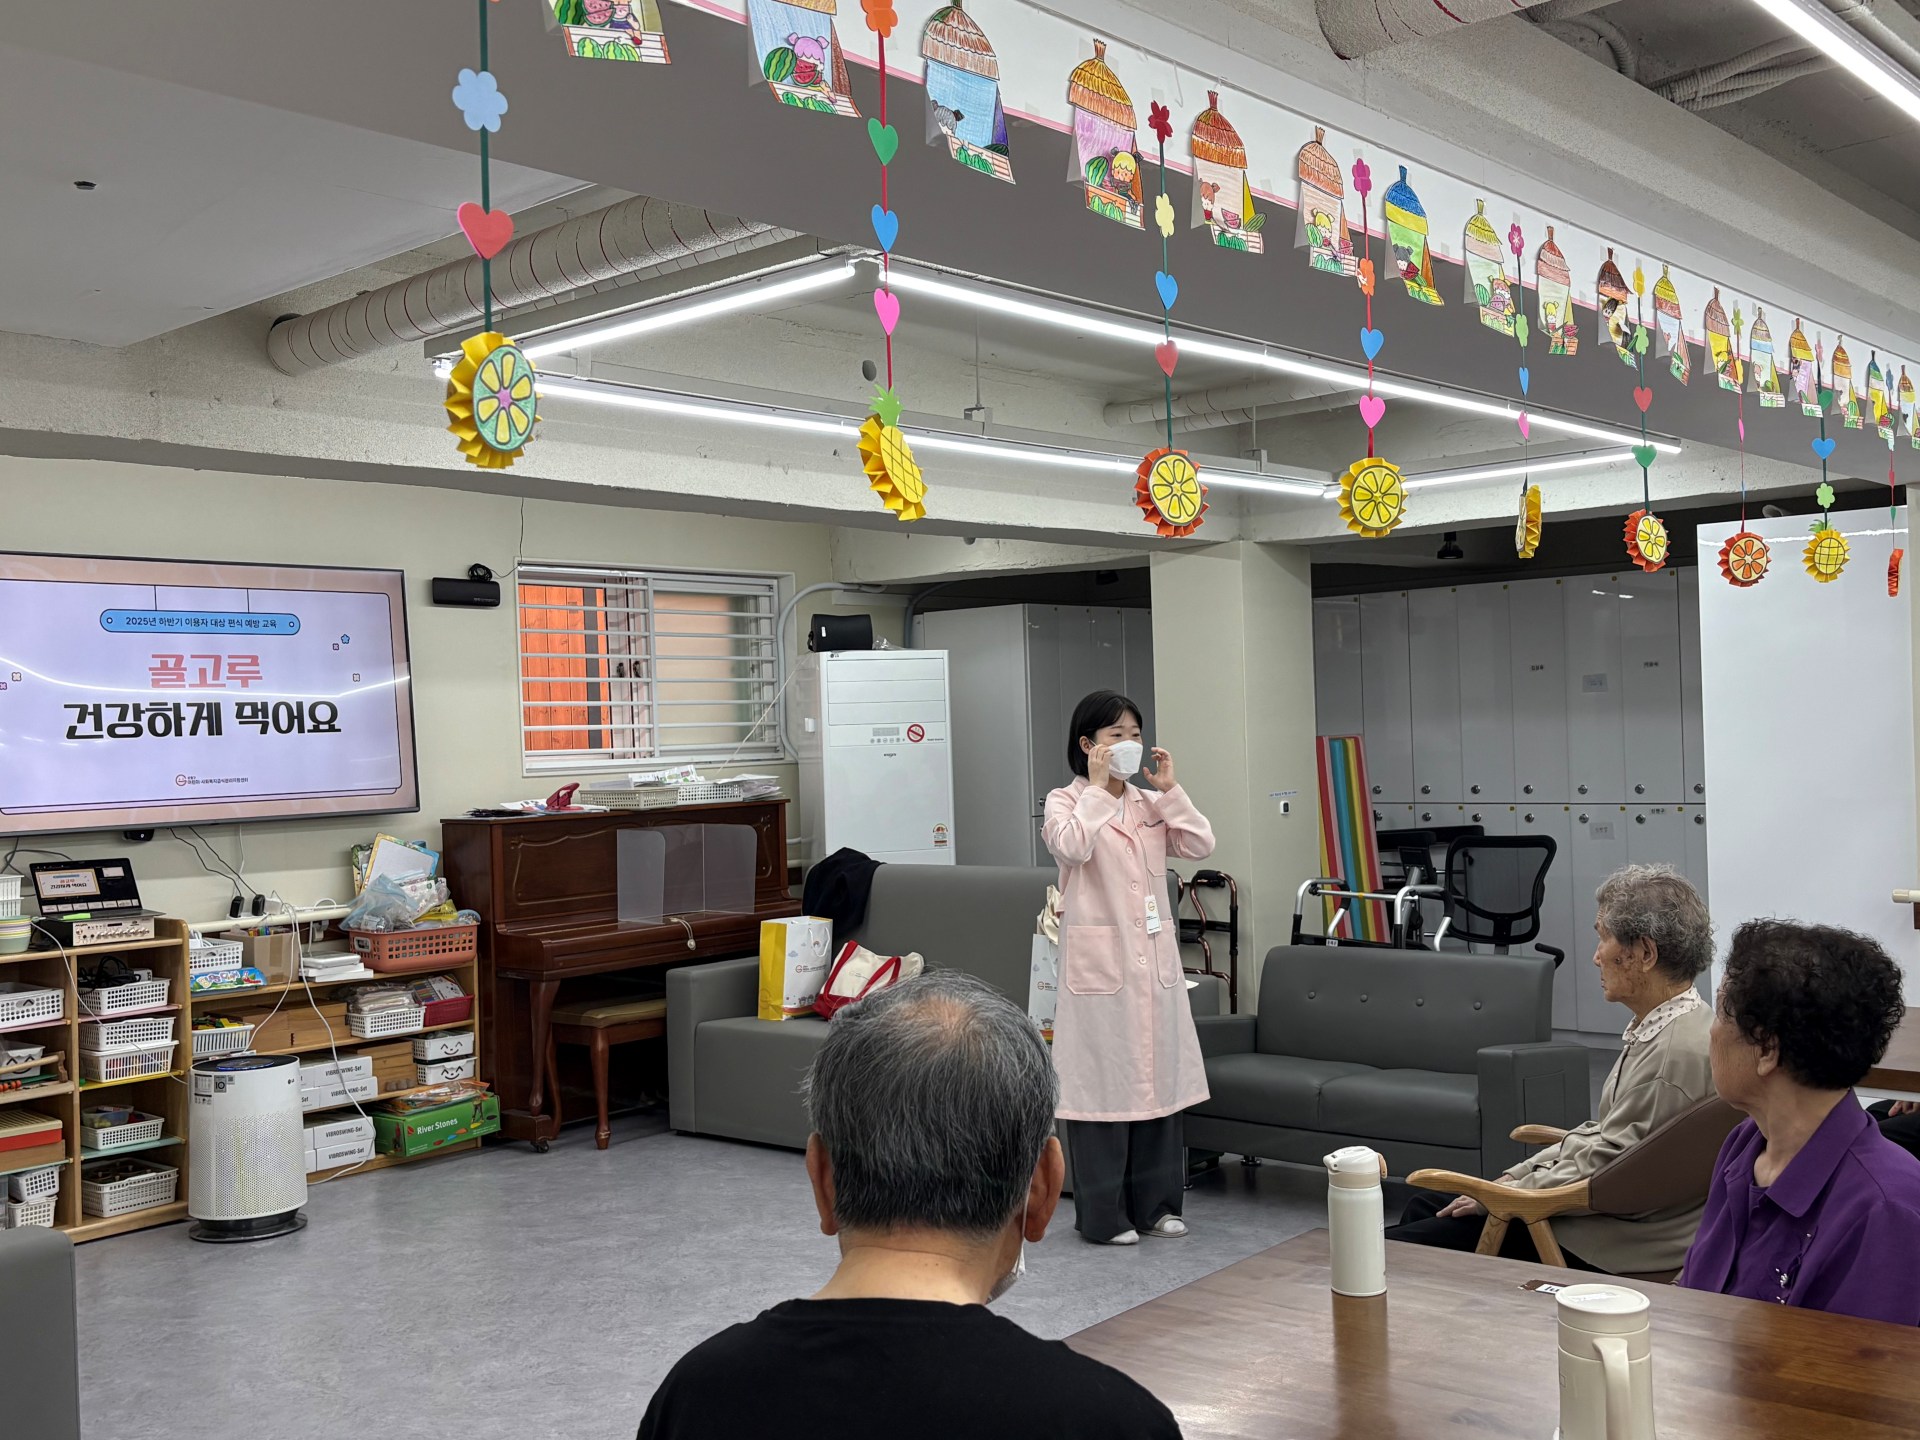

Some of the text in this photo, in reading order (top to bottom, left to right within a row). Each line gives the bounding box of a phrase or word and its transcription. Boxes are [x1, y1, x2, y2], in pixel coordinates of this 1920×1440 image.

[126, 617, 278, 629] 2025년 하반기 이용자 대상 편식 예방 교육
[148, 653, 263, 689] 골고루
[63, 700, 342, 740] 건강하게 먹어요
[325, 1126, 363, 1138] VIBROSWING-Set
[417, 1118, 458, 1135] River Stones
[328, 1147, 365, 1160] VIBROSWING-Set
